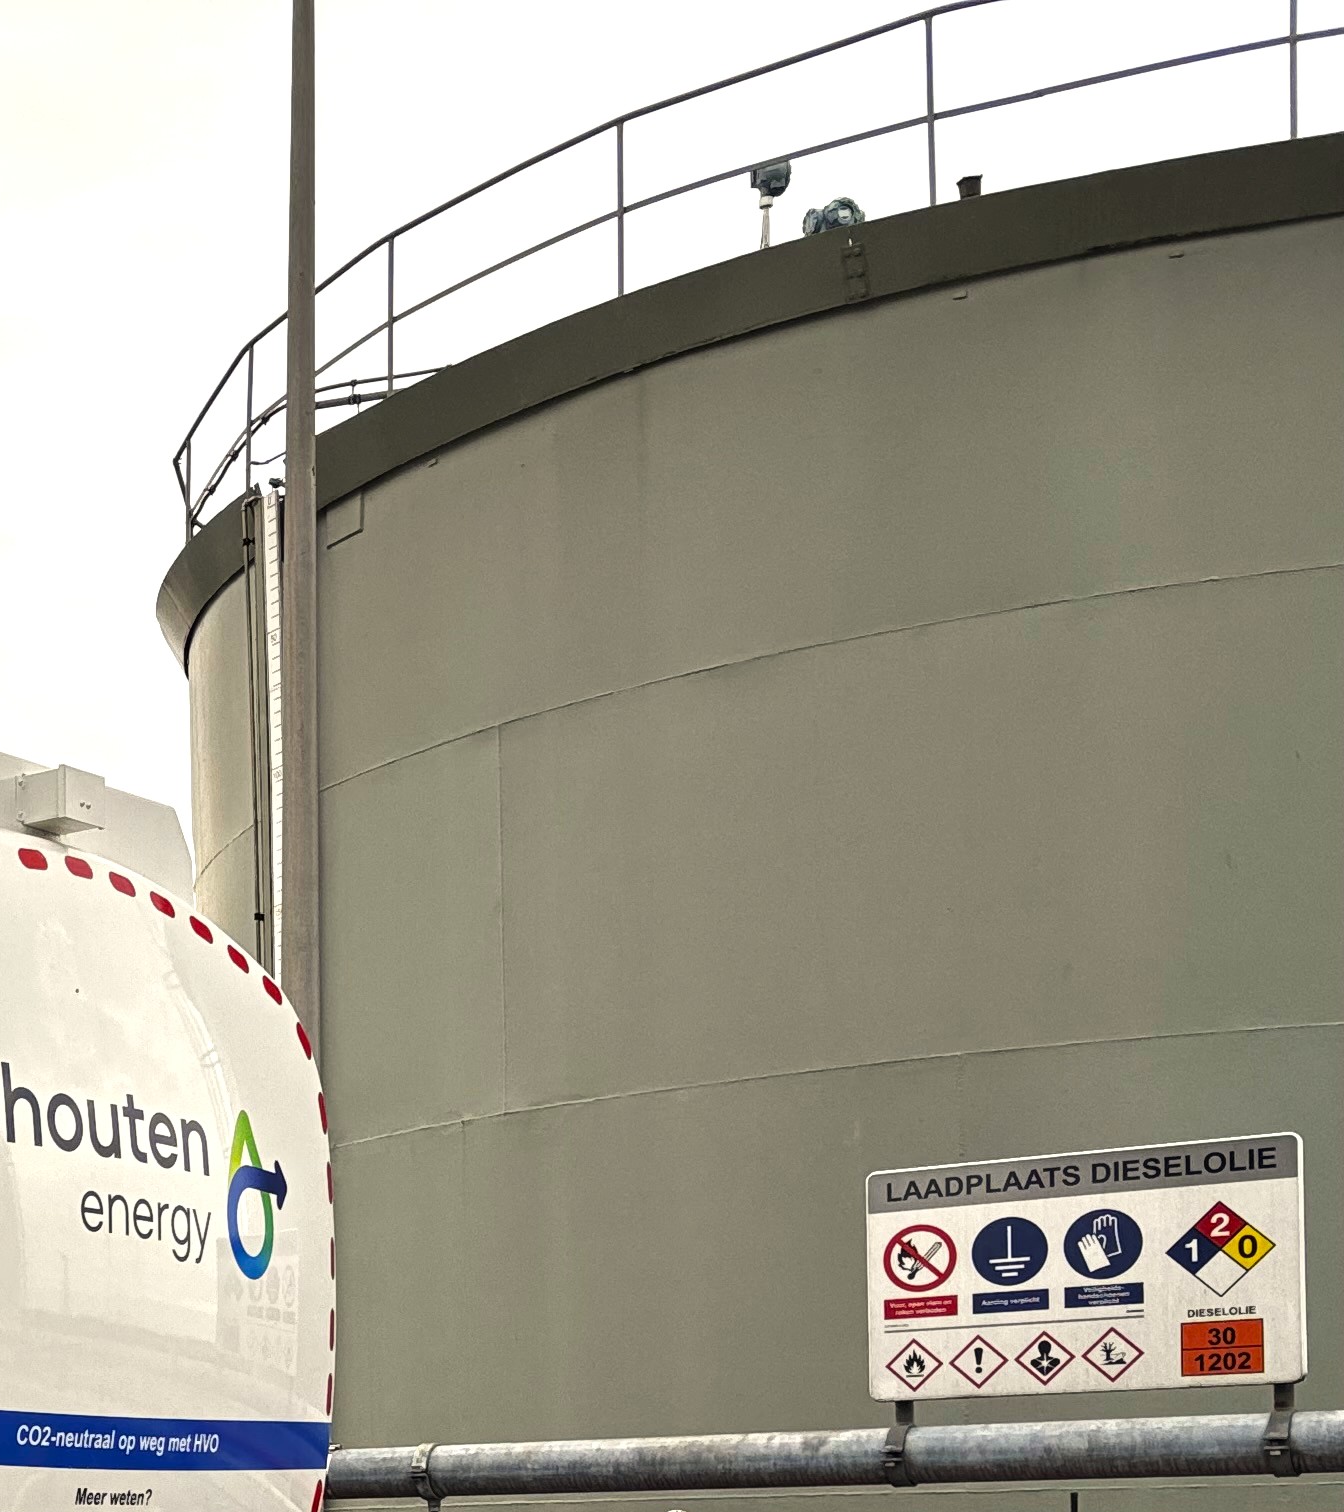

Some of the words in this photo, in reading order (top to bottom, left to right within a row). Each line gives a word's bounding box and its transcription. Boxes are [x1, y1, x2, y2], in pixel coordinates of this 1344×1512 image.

[886, 1165, 1081, 1203] LAADPLAATS
[1091, 1147, 1277, 1184] DIESELOLIE
[80, 1190, 211, 1264] energy
[1210, 1212, 1231, 1237] 2
[1184, 1238, 1199, 1263] 1
[1238, 1234, 1258, 1259] 0
[1187, 1305, 1257, 1318] DIESELOLIE
[1207, 1327, 1236, 1346] 30
[1194, 1351, 1252, 1372] 1202
[16, 1424, 116, 1450] CO2-neutraal
[118, 1433, 136, 1455] op
[139, 1433, 165, 1457] weg
[167, 1433, 192, 1453] met
[192, 1433, 220, 1454] HVO
[75, 1487, 108, 1506] Meer
[109, 1488, 153, 1506] weten?
